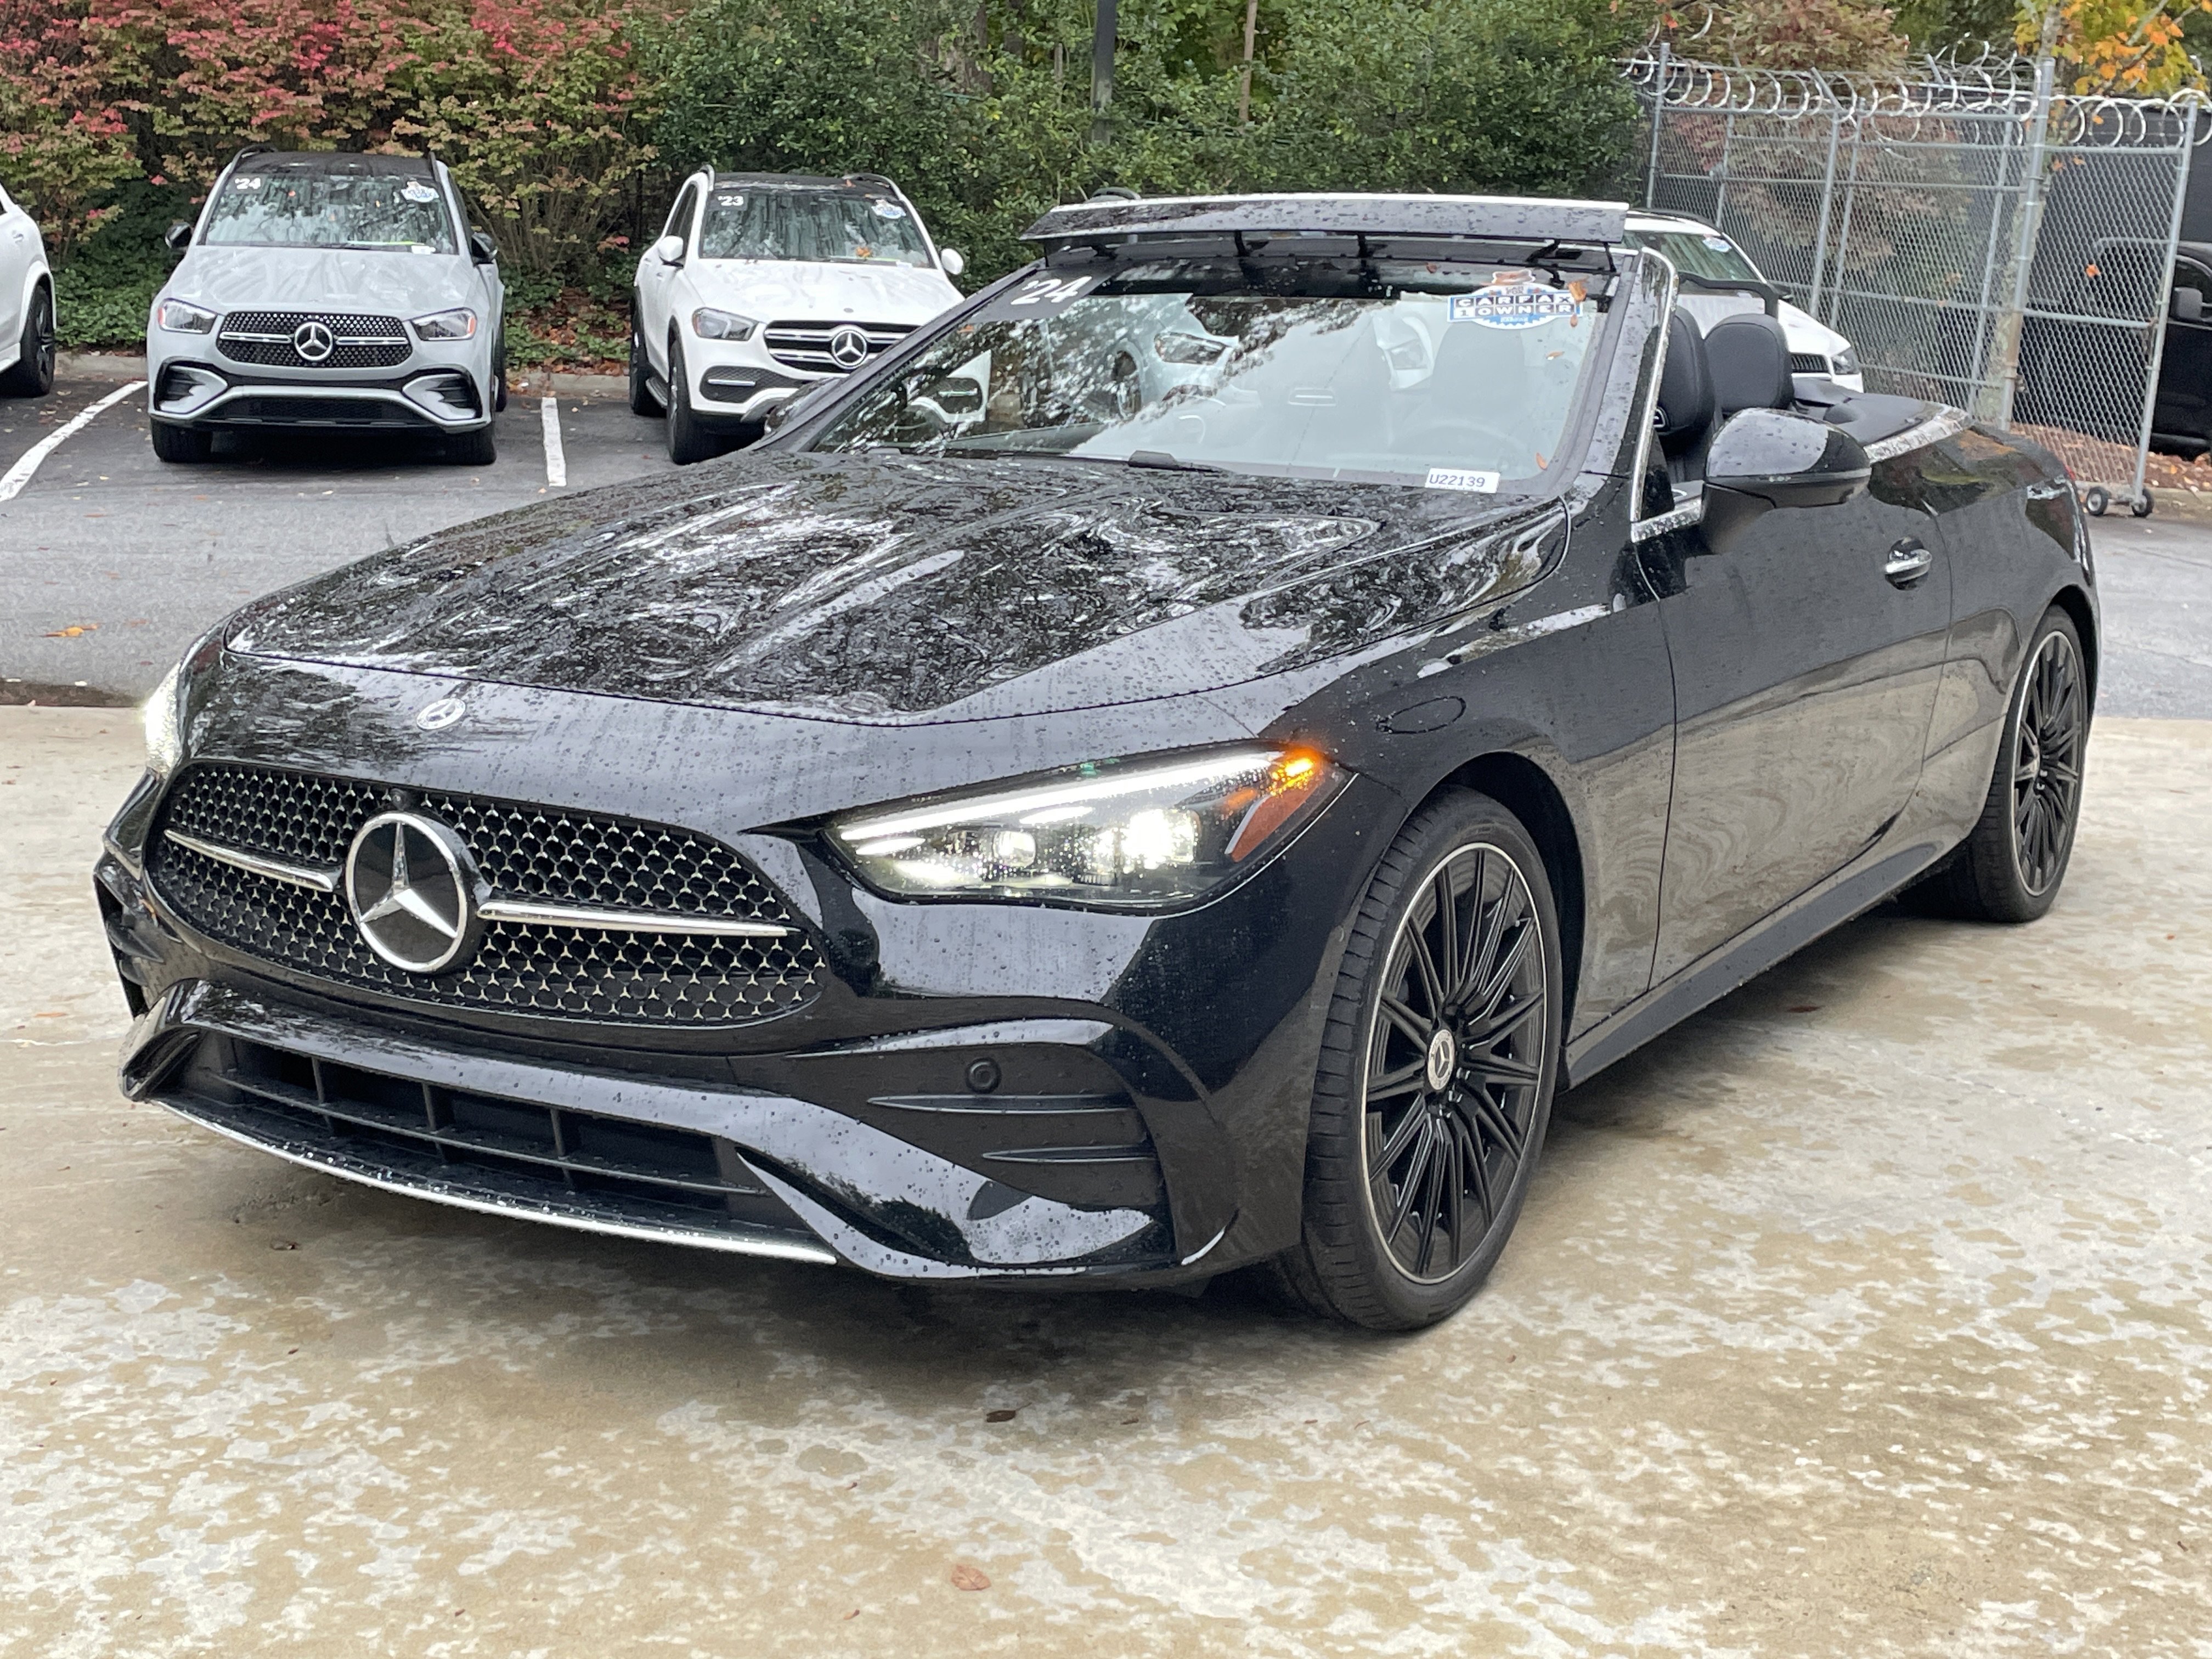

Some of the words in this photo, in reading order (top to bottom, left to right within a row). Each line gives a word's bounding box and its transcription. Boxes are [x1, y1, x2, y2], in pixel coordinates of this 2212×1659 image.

[1458, 295, 1571, 307] CARFAX
[1477, 304, 1572, 316] OWNER
[1429, 474, 1486, 487] U22139
